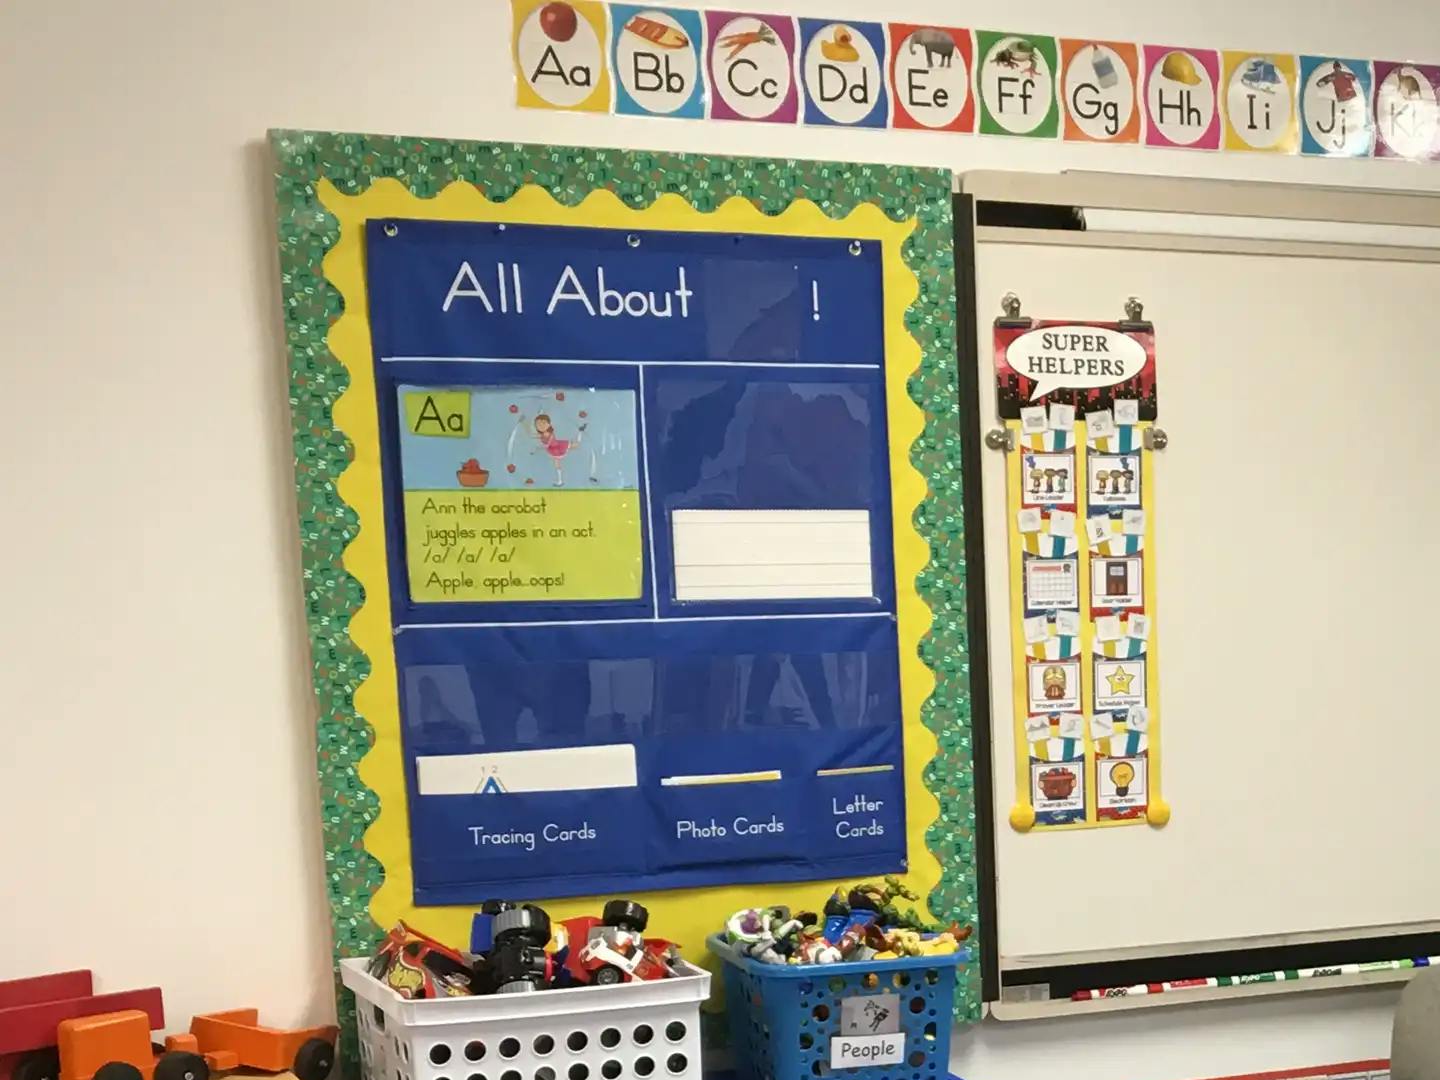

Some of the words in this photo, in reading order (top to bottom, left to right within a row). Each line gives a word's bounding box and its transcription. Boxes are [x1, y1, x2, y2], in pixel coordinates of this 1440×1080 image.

[531, 45, 591, 88] Aa
[633, 52, 685, 94] Bb
[727, 59, 778, 99] Cc
[818, 66, 868, 105] Dd
[908, 69, 949, 108] Ee
[997, 76, 1035, 115] Ff
[1072, 83, 1119, 136] Gg
[1158, 88, 1201, 127] Hh
[1246, 94, 1271, 130] Ii
[1316, 100, 1346, 149] Jj
[442, 261, 524, 313] All
[546, 265, 694, 318] About
[812, 280, 821, 321] !
[1042, 332, 1109, 352] SUPER
[1027, 356, 1125, 376] HELPERS
[414, 395, 464, 432] Aa
[422, 497, 457, 514] Ann
[462, 496, 486, 514] the
[491, 496, 547, 514] acrobat
[422, 522, 476, 546] juggles
[480, 522, 527, 545] apples
[532, 527, 544, 538] in
[549, 527, 567, 539] an
[832, 797, 884, 816] Letter
[468, 826, 535, 851] Tracing
[544, 825, 596, 843] Cards
[676, 819, 727, 839] Photo
[733, 817, 784, 836] Cards
[835, 819, 884, 838] Cards
[841, 1040, 895, 1060] People
